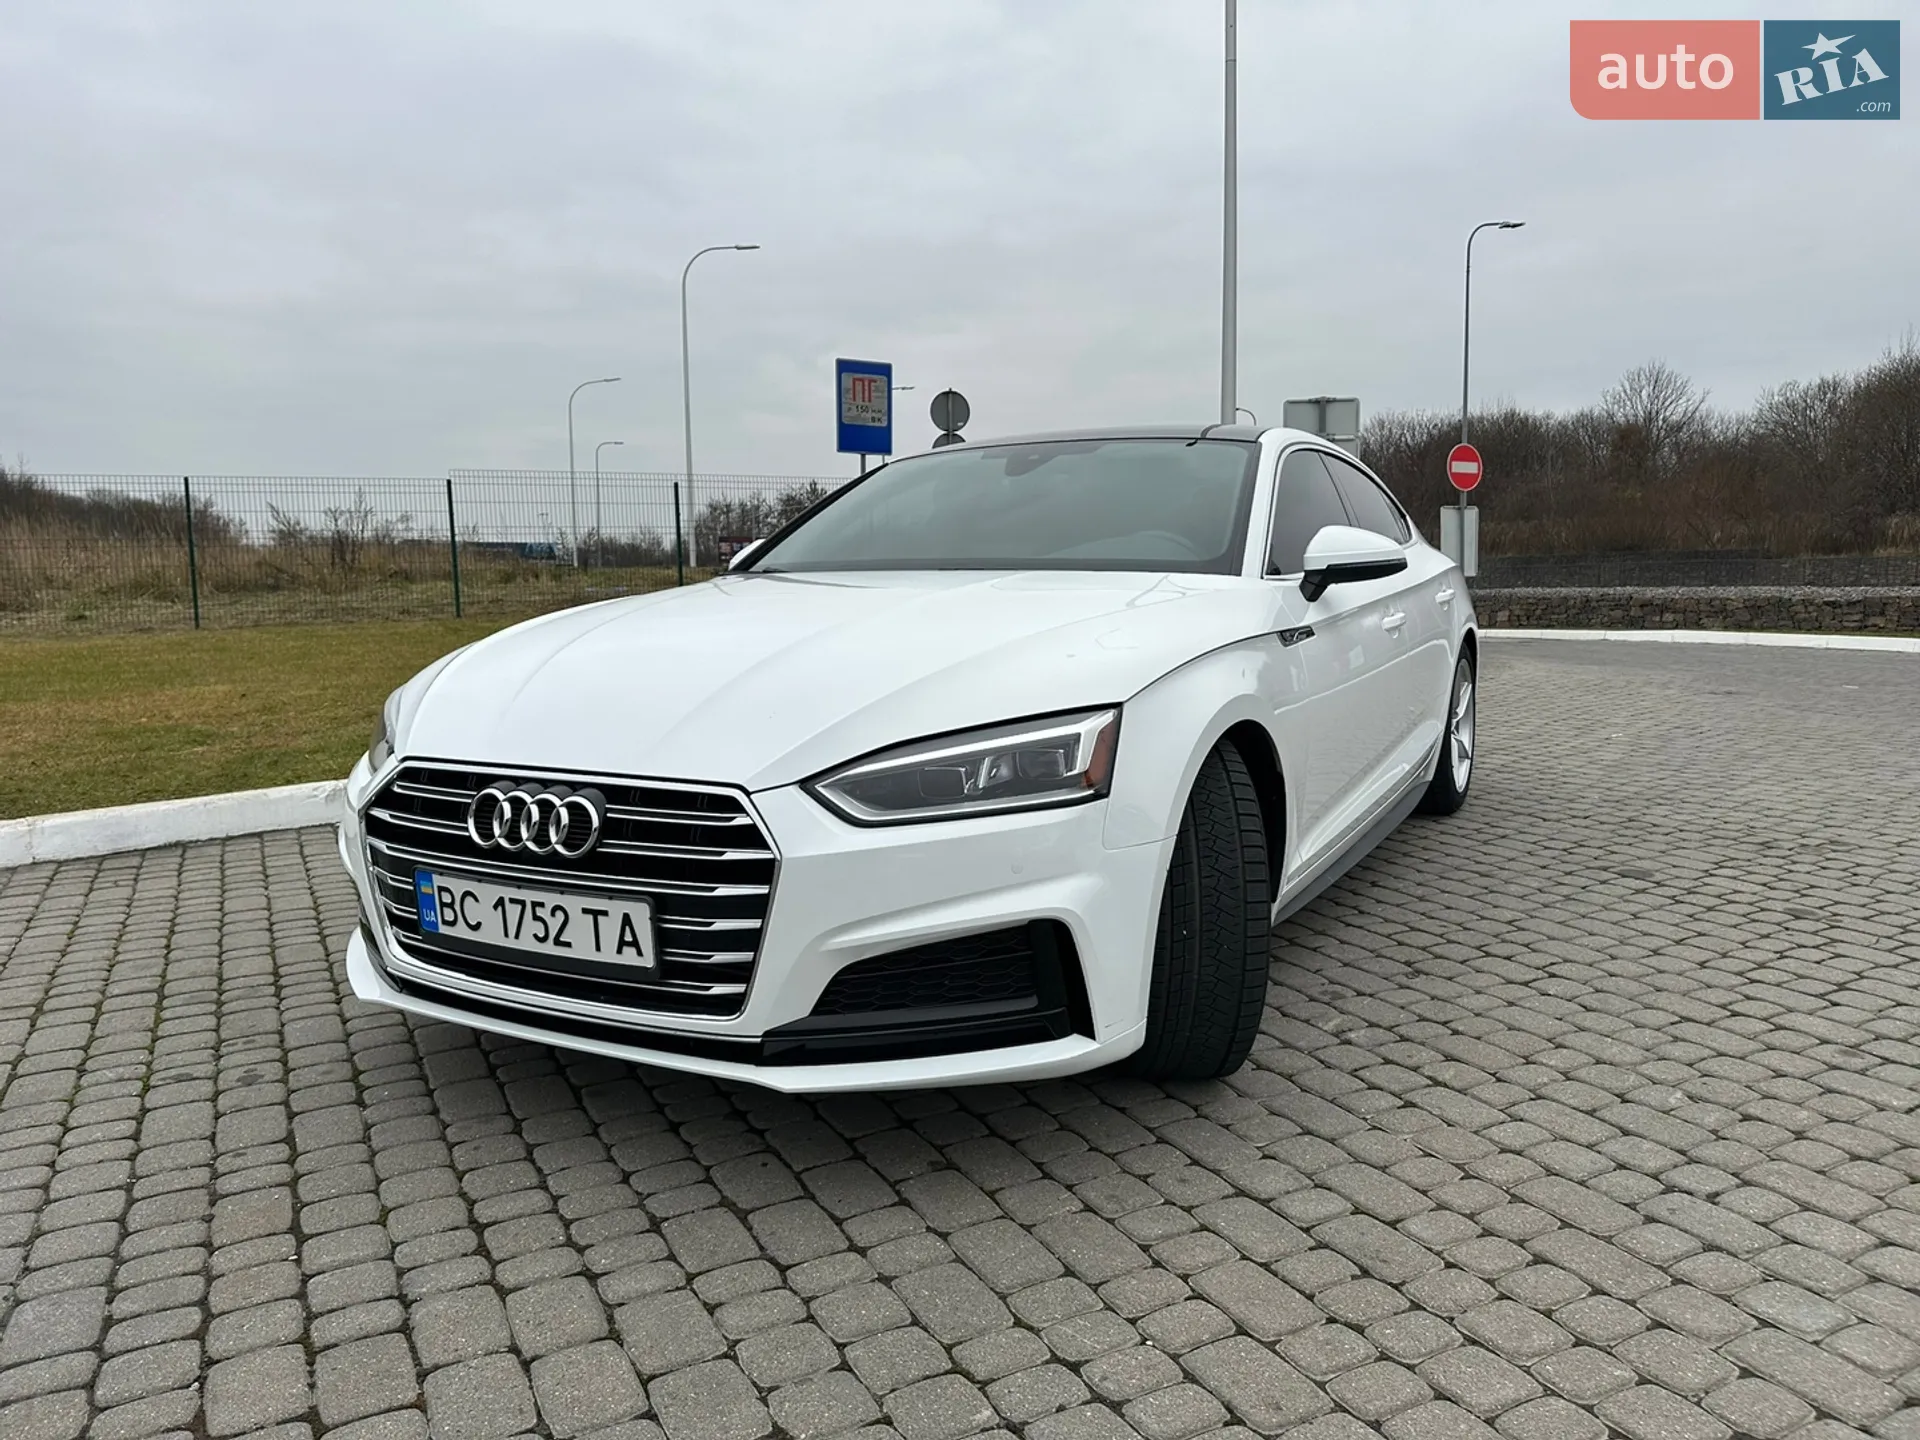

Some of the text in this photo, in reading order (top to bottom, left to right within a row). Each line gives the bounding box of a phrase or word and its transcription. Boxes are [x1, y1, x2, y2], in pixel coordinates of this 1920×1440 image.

[855, 404, 869, 414] 150
[423, 908, 437, 923] UA
[437, 885, 644, 958] BC 1752 TA
